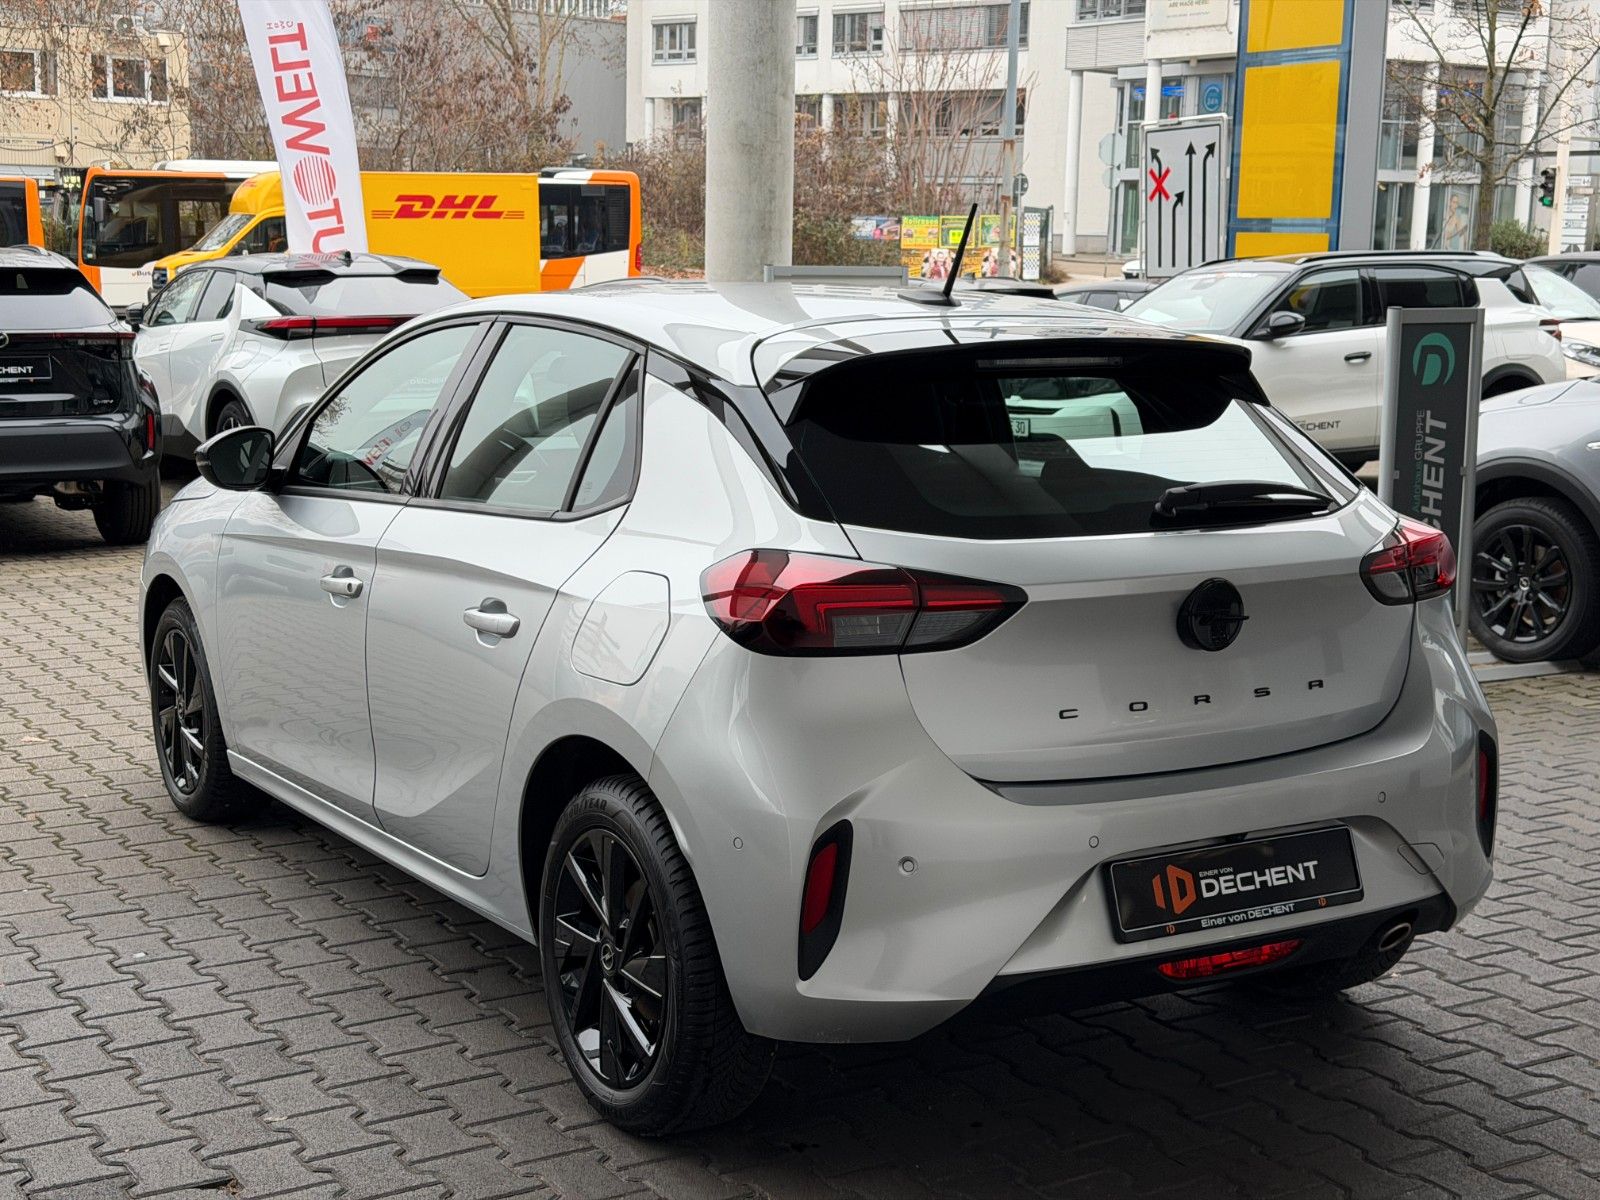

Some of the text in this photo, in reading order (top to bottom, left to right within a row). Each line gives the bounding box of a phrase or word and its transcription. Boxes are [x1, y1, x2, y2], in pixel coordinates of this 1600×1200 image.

[393, 194, 504, 219] DHL
[1059, 679, 1324, 720] CORSA
[1199, 866, 1233, 877] EINER VON
[1200, 860, 1318, 899] DECHENT
[1201, 903, 1296, 928] Einer von DECHENT
